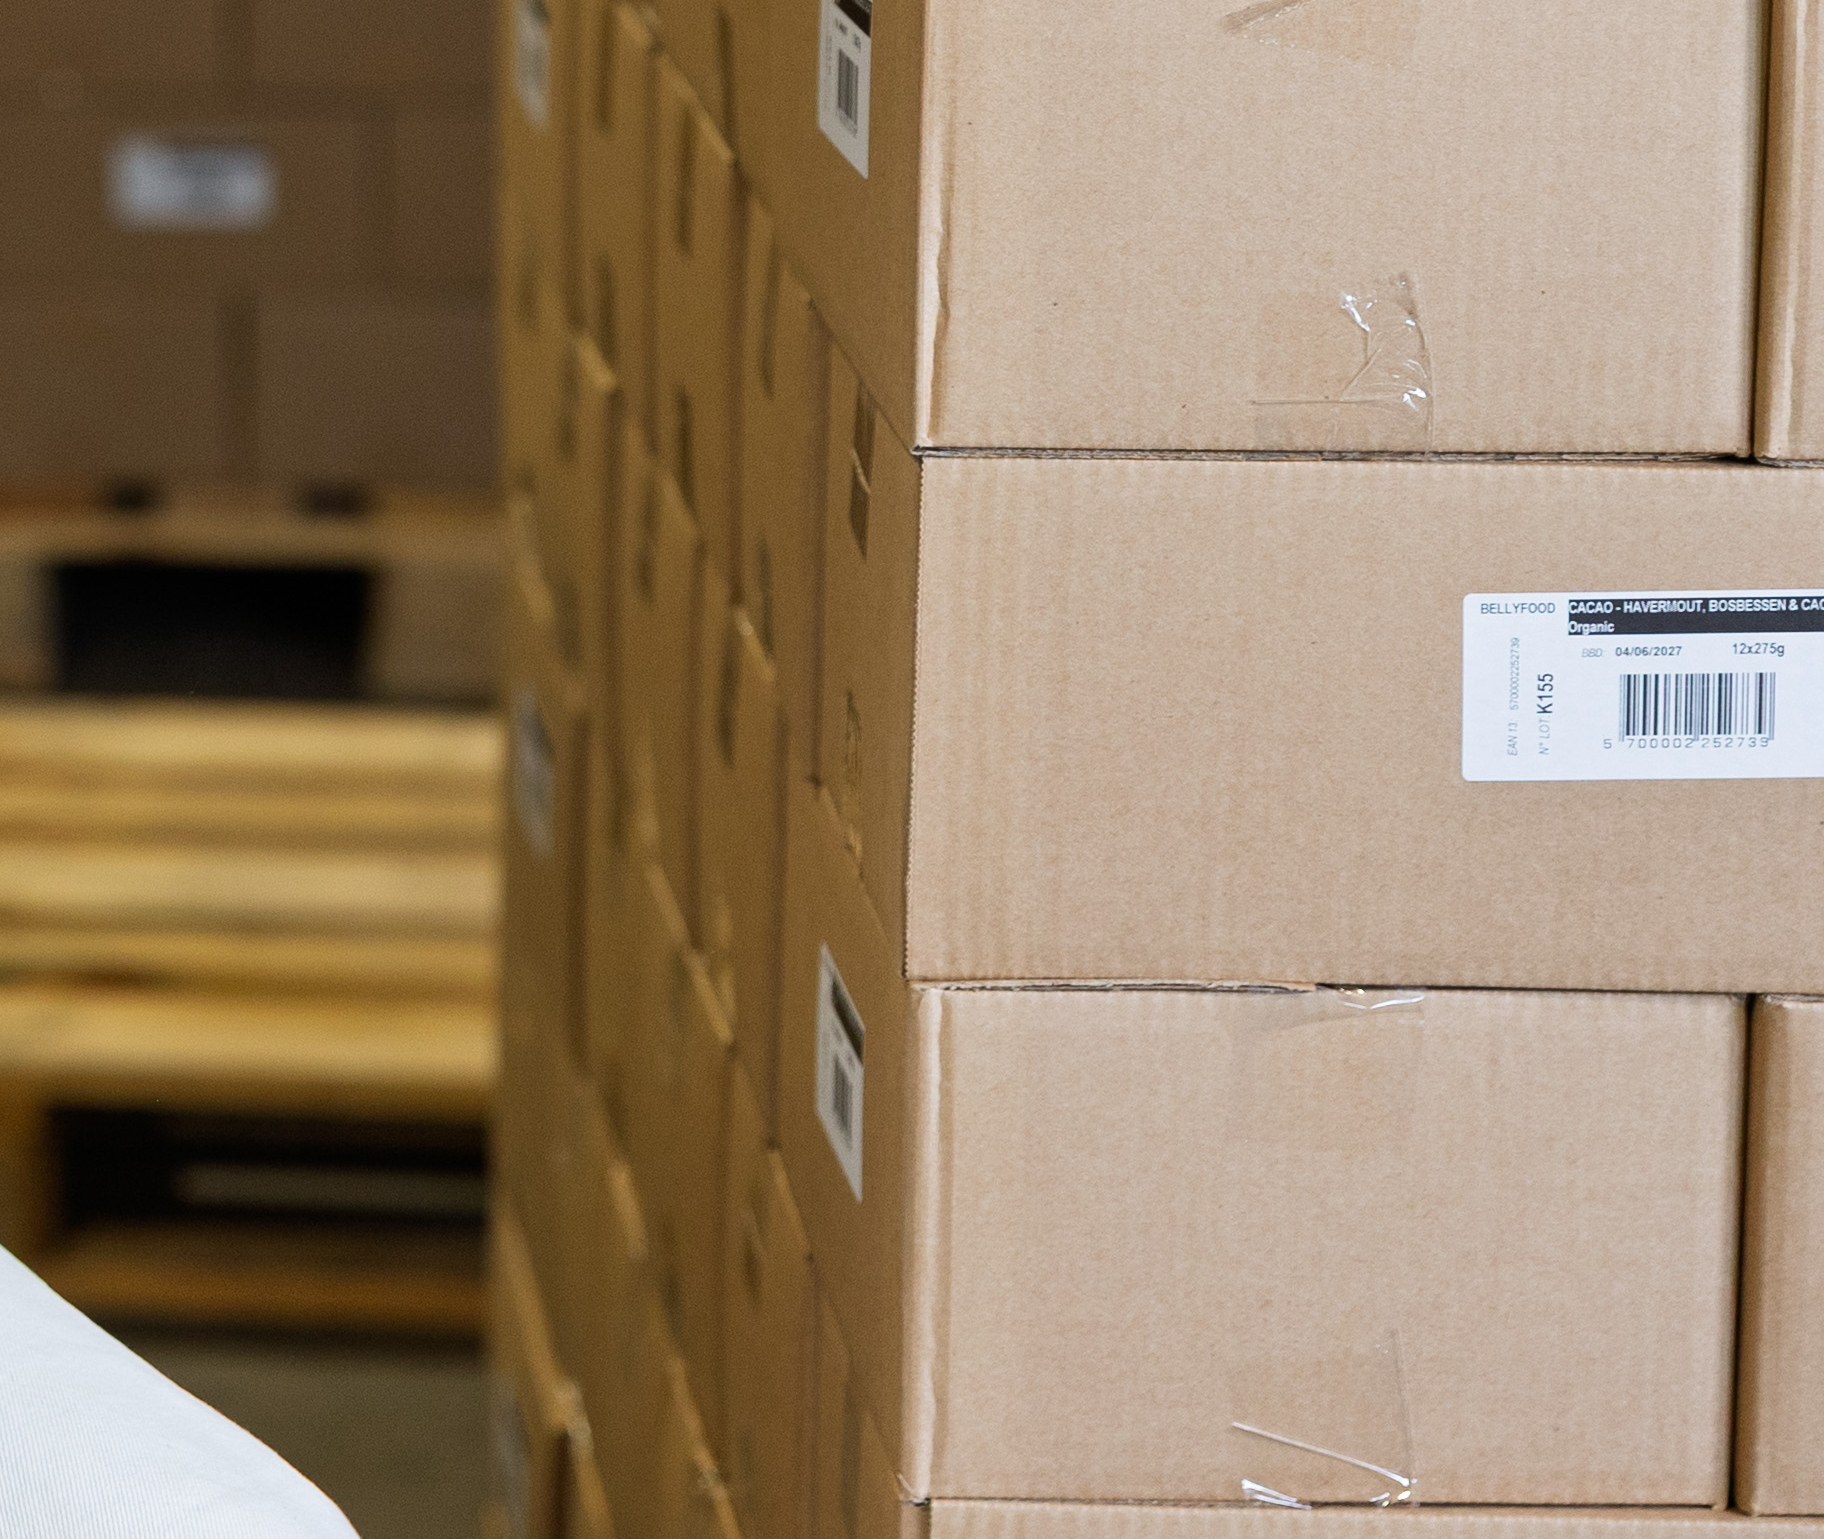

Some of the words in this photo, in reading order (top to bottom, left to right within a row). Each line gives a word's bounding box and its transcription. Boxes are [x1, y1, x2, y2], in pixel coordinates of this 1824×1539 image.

[1480, 602, 1556, 614] BELLYFOOD
[1568, 601, 1614, 614] CACAO
[1623, 599, 1706, 613] HAVERMOUT,
[1708, 599, 1787, 612] BOSBESSEN
[1788, 599, 1799, 611] &
[1568, 621, 1615, 635] Organic
[1614, 645, 1683, 657] 04/06/2027
[1732, 642, 1785, 657] 12x275g
[1536, 673, 1554, 714] K155
[1507, 735, 1518, 756] EAN
[1603, 738, 1612, 749] 5
[1627, 738, 1694, 749] 700002
